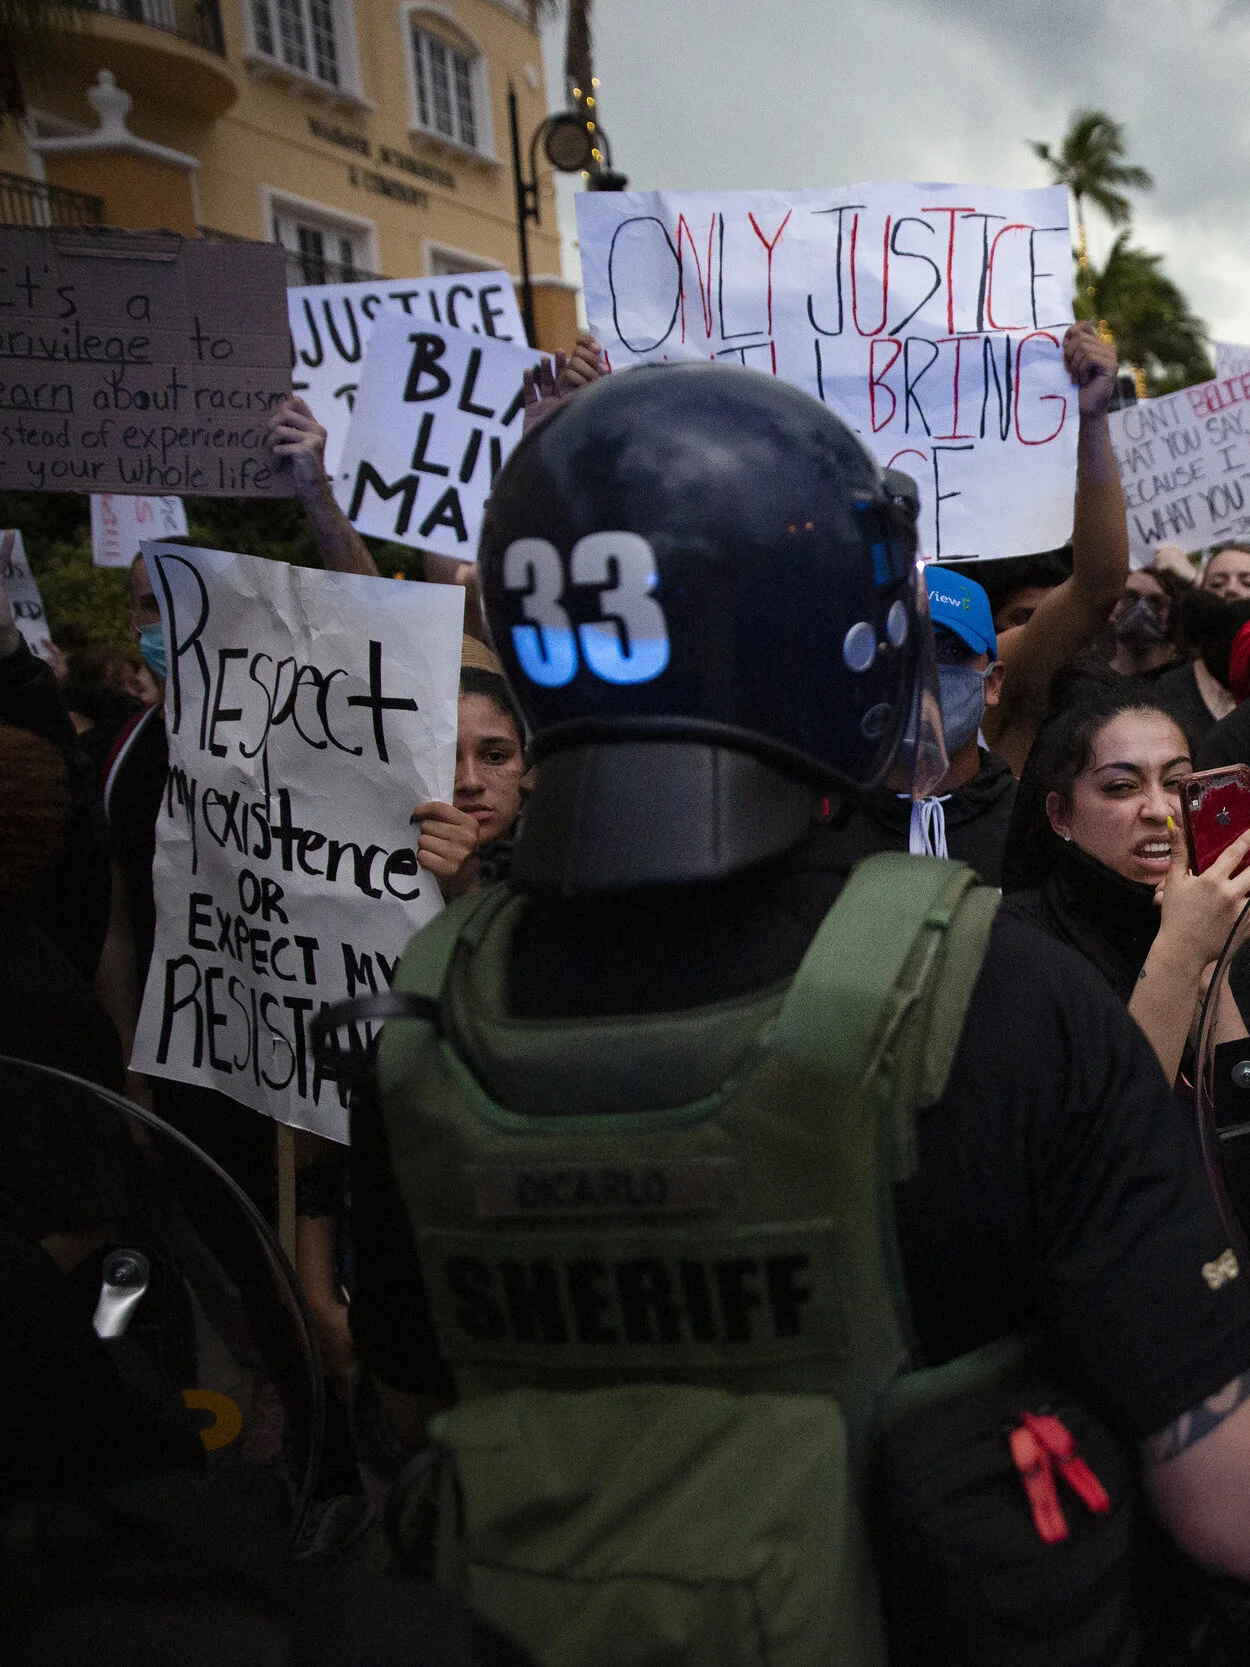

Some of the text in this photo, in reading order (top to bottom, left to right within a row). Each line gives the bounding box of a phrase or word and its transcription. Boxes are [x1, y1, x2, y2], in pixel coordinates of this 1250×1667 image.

[126, 293, 150, 321] a
[608, 204, 1073, 352] ONLY JUSTICE
[0, 315, 234, 384] rivilege to
[868, 331, 1067, 445] BRING
[27, 456, 105, 489] your
[218, 456, 273, 490] life
[81, 419, 116, 447] of
[123, 418, 269, 465] experienci
[1124, 457, 1207, 509] ECAUSE
[1217, 443, 1246, 472] I
[348, 460, 469, 543] MA
[1134, 495, 1197, 545] WHAT
[1197, 479, 1245, 524] YOU
[503, 530, 671, 688] 33
[166, 764, 421, 902] my existence
[238, 868, 290, 925] OR
[187, 892, 319, 986] EXPECT
[446, 1254, 811, 1346] SHERIFF
